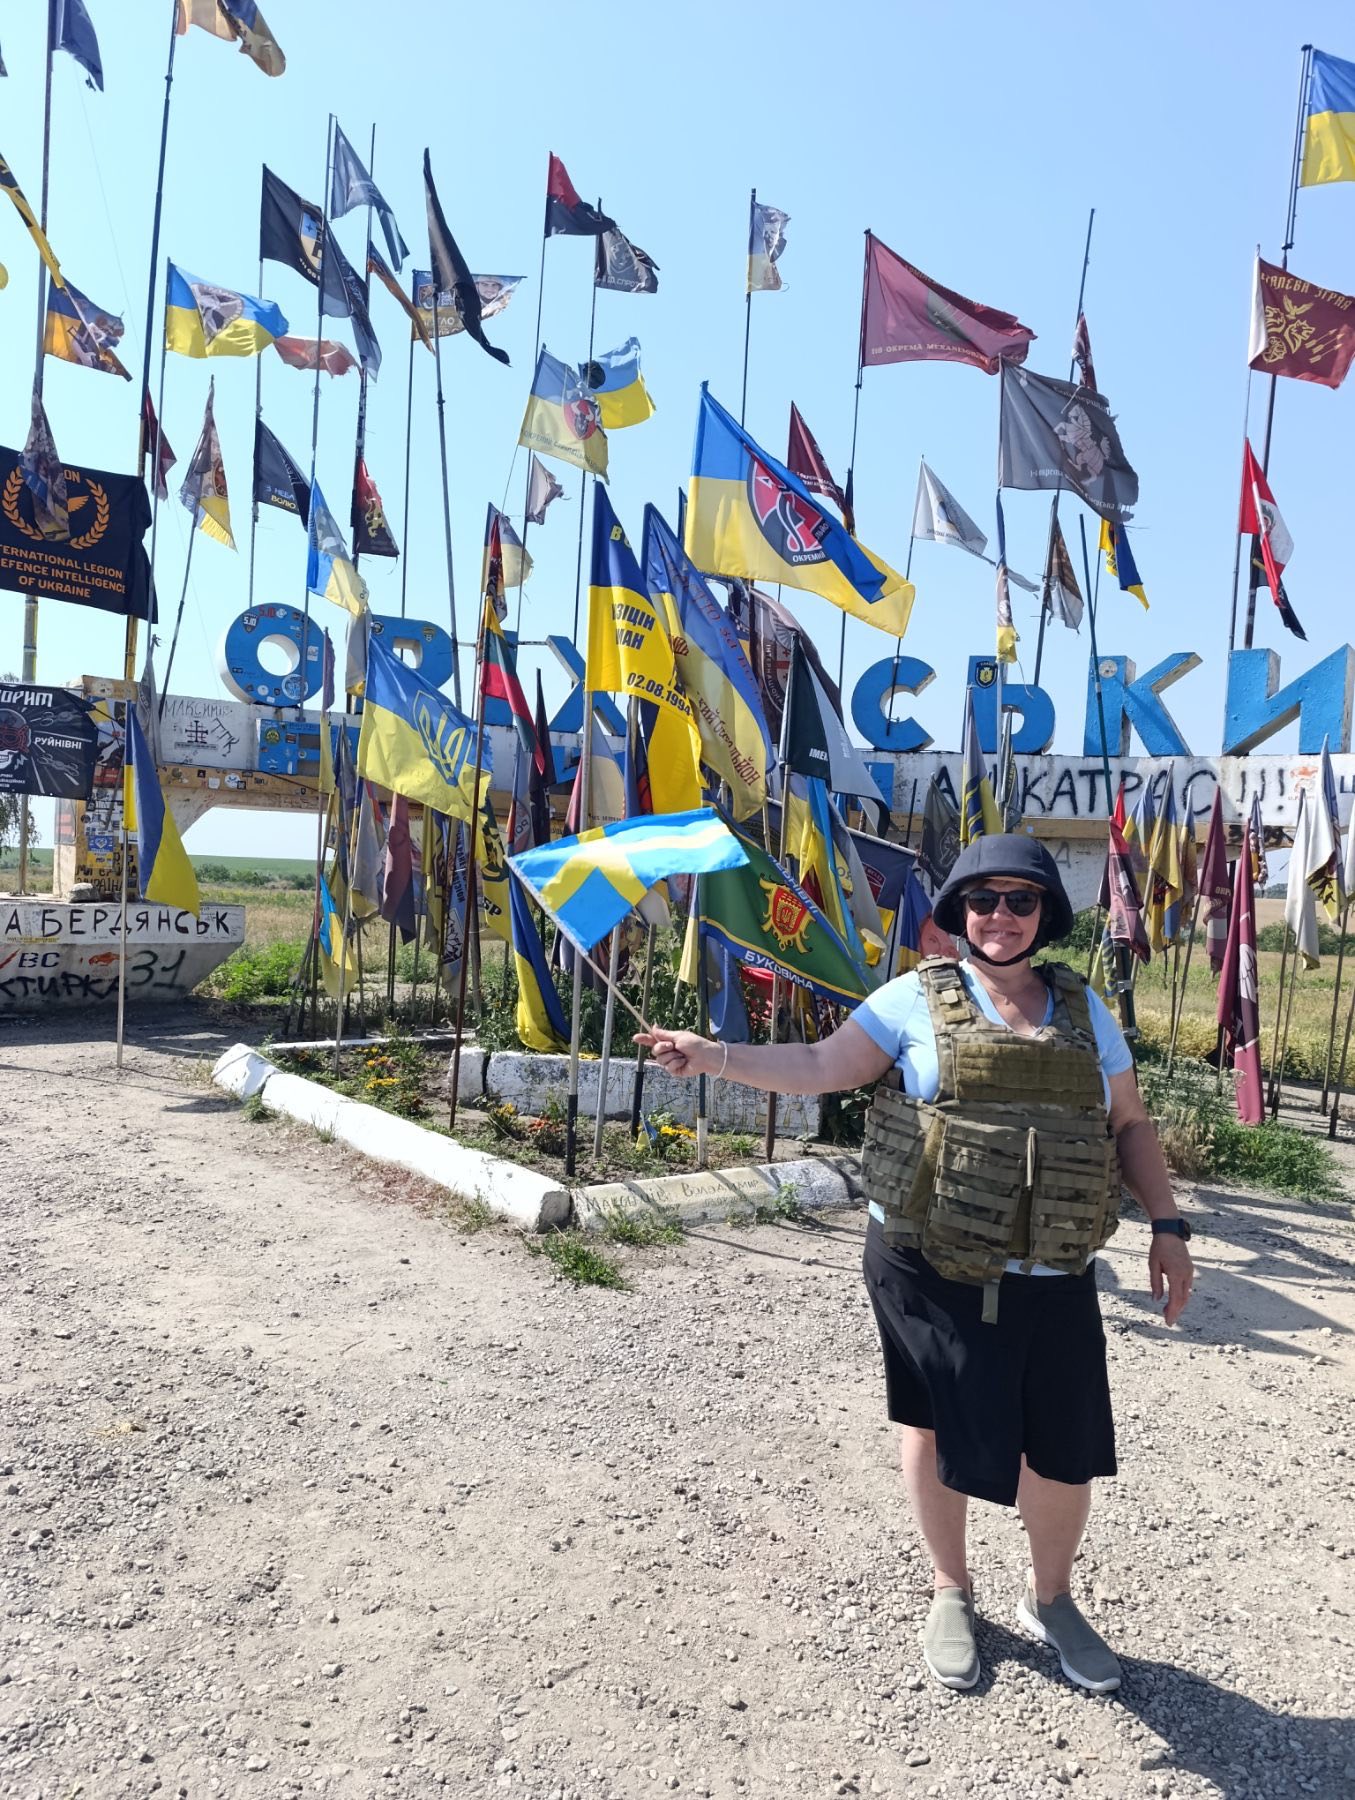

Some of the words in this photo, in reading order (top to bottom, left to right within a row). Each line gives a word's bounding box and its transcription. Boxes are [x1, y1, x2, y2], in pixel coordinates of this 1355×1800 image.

[0, 557, 49, 576] EFENCE
[83, 561, 123, 580] LEGION
[18, 574, 36, 587] OF
[38, 578, 92, 599] UKRAINE
[34, 736, 83, 750] РУЙНІВНІ
[41, 907, 230, 938] БЕРДЯНСЬК
[744, 950, 815, 991] БУКОВИНА
